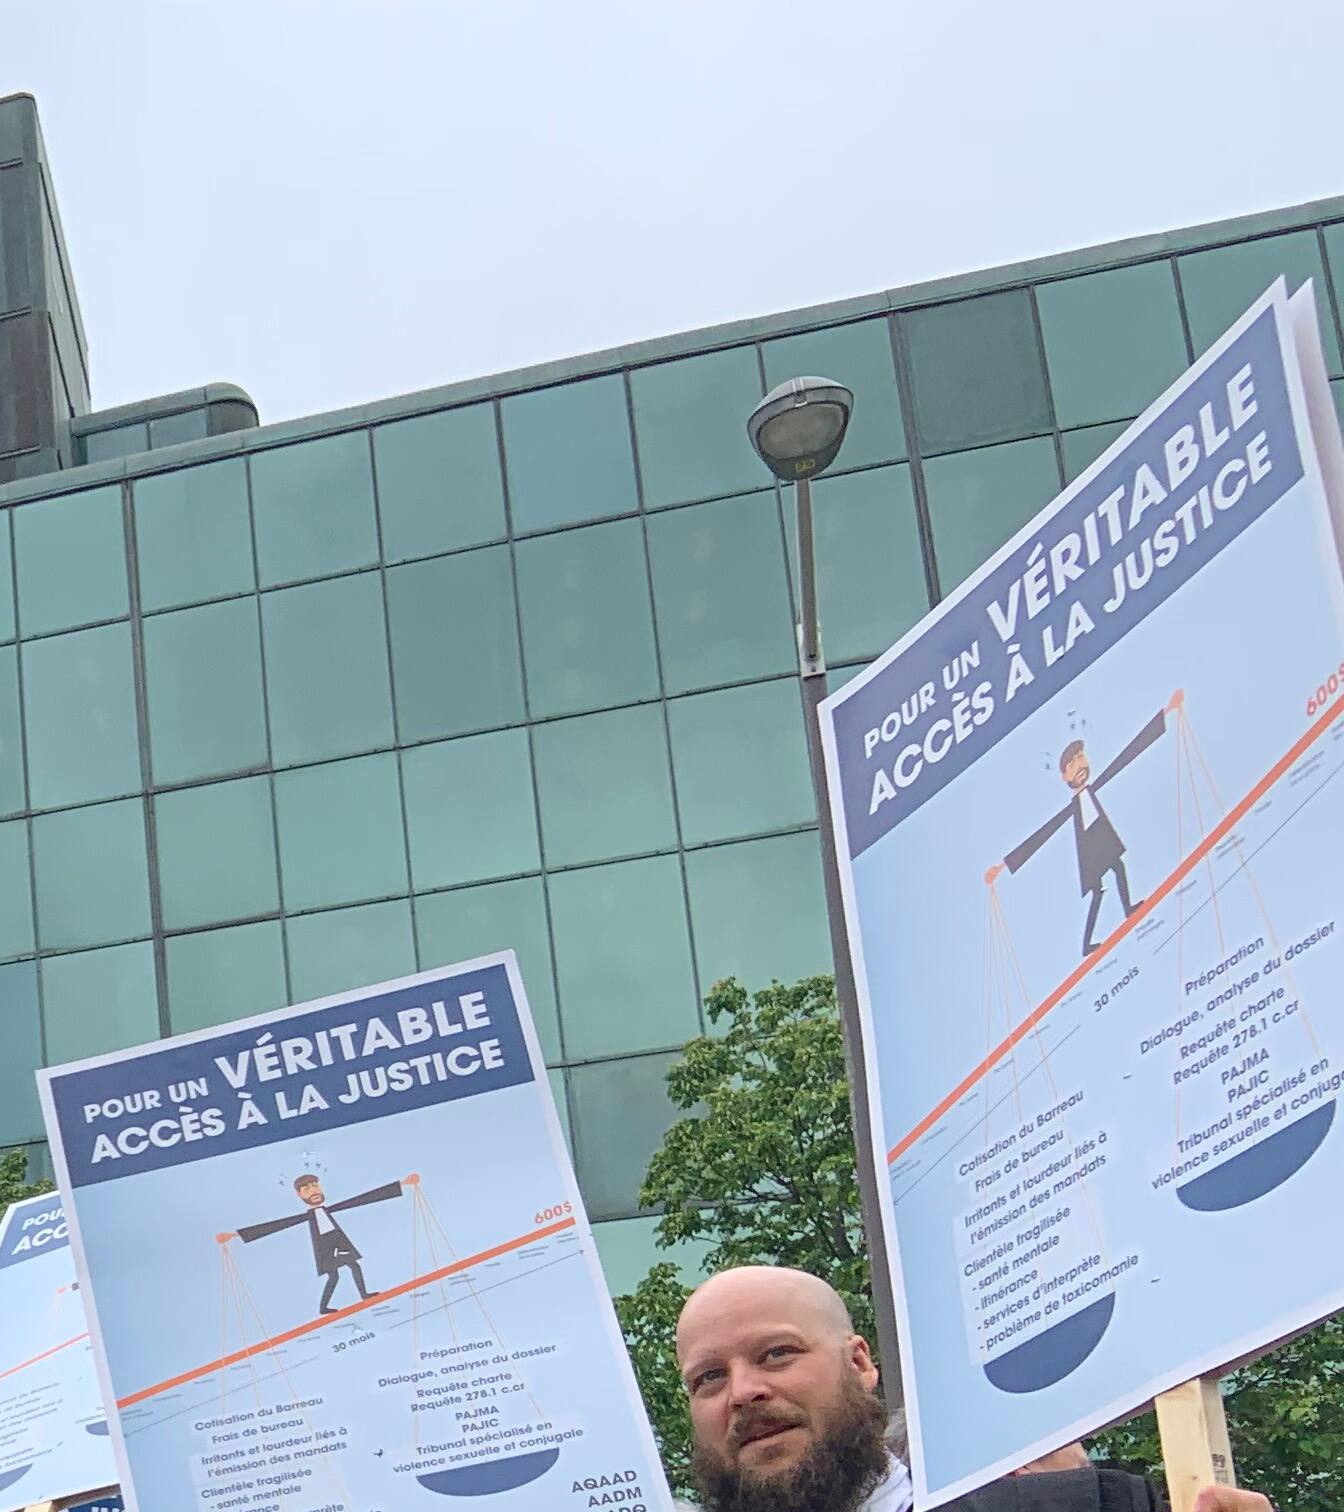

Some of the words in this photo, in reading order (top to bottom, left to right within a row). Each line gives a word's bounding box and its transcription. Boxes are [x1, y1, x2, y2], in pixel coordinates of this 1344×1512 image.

[865, 682, 935, 758] POUR
[943, 641, 979, 689] UN
[986, 363, 1257, 642] VÉRITABLE
[869, 681, 993, 814] ACCÈS
[1043, 601, 1094, 666] LA
[1104, 430, 1271, 612] JUSTICE
[1185, 937, 1264, 995] Préparation
[1094, 993, 1108, 1011] 30
[1111, 967, 1139, 996] mois
[1140, 1011, 1203, 1054] Dialogue,
[1207, 972, 1259, 1011] analyse
[1263, 957, 1280, 974] du
[1285, 921, 1334, 960] dossier
[1180, 1019, 1235, 1059] Requête
[1240, 988, 1284, 1021] charte
[84, 1090, 161, 1122] POUR
[168, 1077, 208, 1102] UN
[214, 991, 490, 1088] VÉRITABLE
[1173, 1045, 1228, 1084] Requête
[1232, 1018, 1266, 1048] 278.1
[1221, 1048, 1269, 1085] PAJMA
[91, 1106, 225, 1163] ACCÈS
[238, 1092, 267, 1129] À
[275, 1084, 329, 1119] LA
[338, 1039, 504, 1103] JUSTICE
[1228, 1070, 1268, 1102] PAJIC
[1177, 1112, 1232, 1152] Tribunal
[1236, 1068, 1306, 1120] spécialisé
[1311, 1058, 1328, 1075] en
[959, 1135, 1016, 1176] Cotisation
[1019, 1123, 1033, 1138] du
[1036, 1091, 1083, 1126] Barreau
[1152, 1152, 1209, 1189] violence
[1213, 1116, 1269, 1155] sexuelle
[1274, 1103, 1286, 1120] et
[975, 1170, 1001, 1192] Frais
[1004, 1158, 1018, 1173] de
[1021, 1130, 1063, 1162] bureau
[965, 1195, 1006, 1227] Irritants
[1009, 1184, 1020, 1199] et
[1023, 1154, 1071, 1191] lourdeur
[1075, 1140, 1095, 1159] liés
[1029, 1189, 1050, 1208] des
[1053, 1155, 1105, 1193] mandats
[22, 1205, 65, 1231] POU
[534, 1201, 573, 1224] 600$
[11, 1223, 69, 1256] ACC
[964, 1242, 1013, 1276] Clientèle
[1016, 1207, 1070, 1245] fragilisée
[332, 1342, 346, 1352] 30
[348, 1332, 375, 1346] mois
[420, 1340, 492, 1360] Préparation
[378, 1370, 437, 1386] Dialogue,
[440, 1359, 488, 1374] analyse
[492, 1355, 508, 1363] du
[511, 1345, 555, 1359] dossier
[411, 1396, 461, 1412] Requête
[465, 1388, 496, 1400] 278.1
[417, 1382, 467, 1397] Requête
[471, 1373, 511, 1386] charte
[195, 1413, 254, 1430] Cotisation
[257, 1408, 272, 1416] du
[276, 1398, 323, 1412] Barreau
[455, 1405, 499, 1420] PAJMA
[462, 1418, 498, 1432] PAJIC
[201, 1450, 245, 1464] Irritants
[248, 1446, 259, 1454] et
[263, 1436, 311, 1451] lourdeur
[315, 1430, 335, 1440] liés
[212, 1432, 239, 1443] Frais
[242, 1428, 257, 1436] de
[260, 1418, 303, 1432] bureau
[416, 1438, 466, 1455] Tribunal
[470, 1424, 532, 1444] spécialisé
[536, 1422, 552, 1430] en
[269, 1454, 290, 1464] des
[294, 1442, 346, 1458] mandats
[393, 1458, 445, 1472] violence
[448, 1446, 500, 1462] sexuelle
[504, 1441, 515, 1450] et
[519, 1429, 583, 1447] conjugale
[201, 1481, 253, 1498] Clientèle
[256, 1468, 311, 1486] fragilisée
[217, 1494, 249, 1509] santé
[253, 1485, 301, 1501] mentale
[572, 1470, 636, 1492] AQAAD
[589, 1487, 641, 1507] AADM
